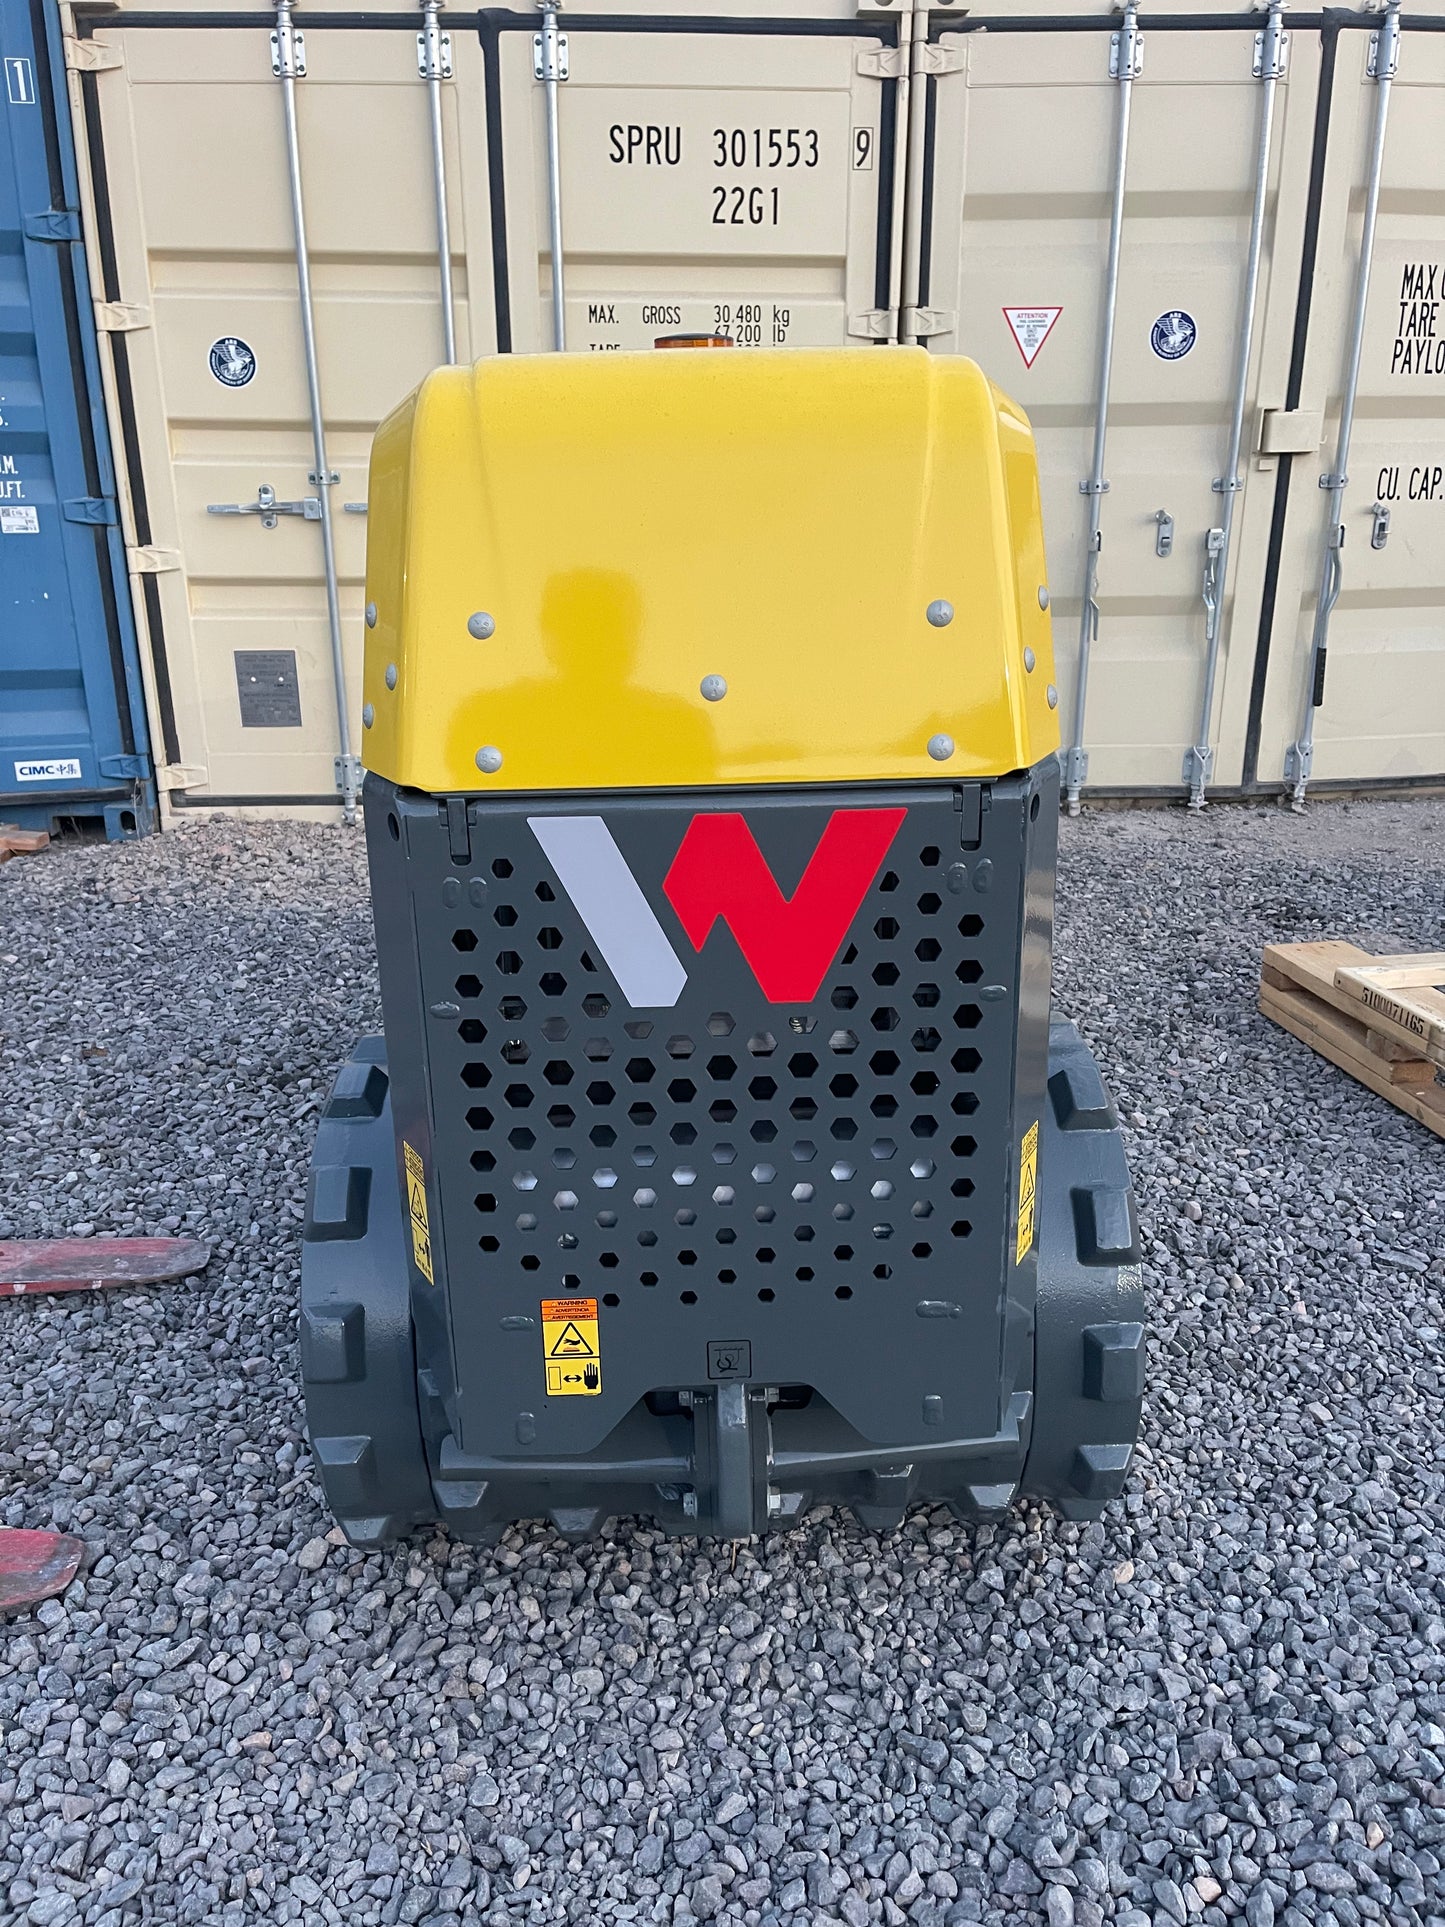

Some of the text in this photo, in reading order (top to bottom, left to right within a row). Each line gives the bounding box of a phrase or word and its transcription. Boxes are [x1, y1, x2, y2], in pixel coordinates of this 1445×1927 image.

[13, 60, 27, 101] 1
[609, 124, 871, 167] SPRU 301553 9
[712, 186, 779, 225] 22G1
[1400, 264, 1438, 300] MAX
[588, 304, 619, 324] MAX.
[642, 305, 681, 325] GROSS
[773, 304, 790, 327] kg
[1398, 302, 1440, 337] TARE
[773, 324, 786, 343] lb
[1391, 339, 1445, 374] PAYLO
[1377, 466, 1444, 500] CU. CAP.
[20, 765, 55, 776] CIMC
[1361, 986, 1425, 1035] 5100071165
